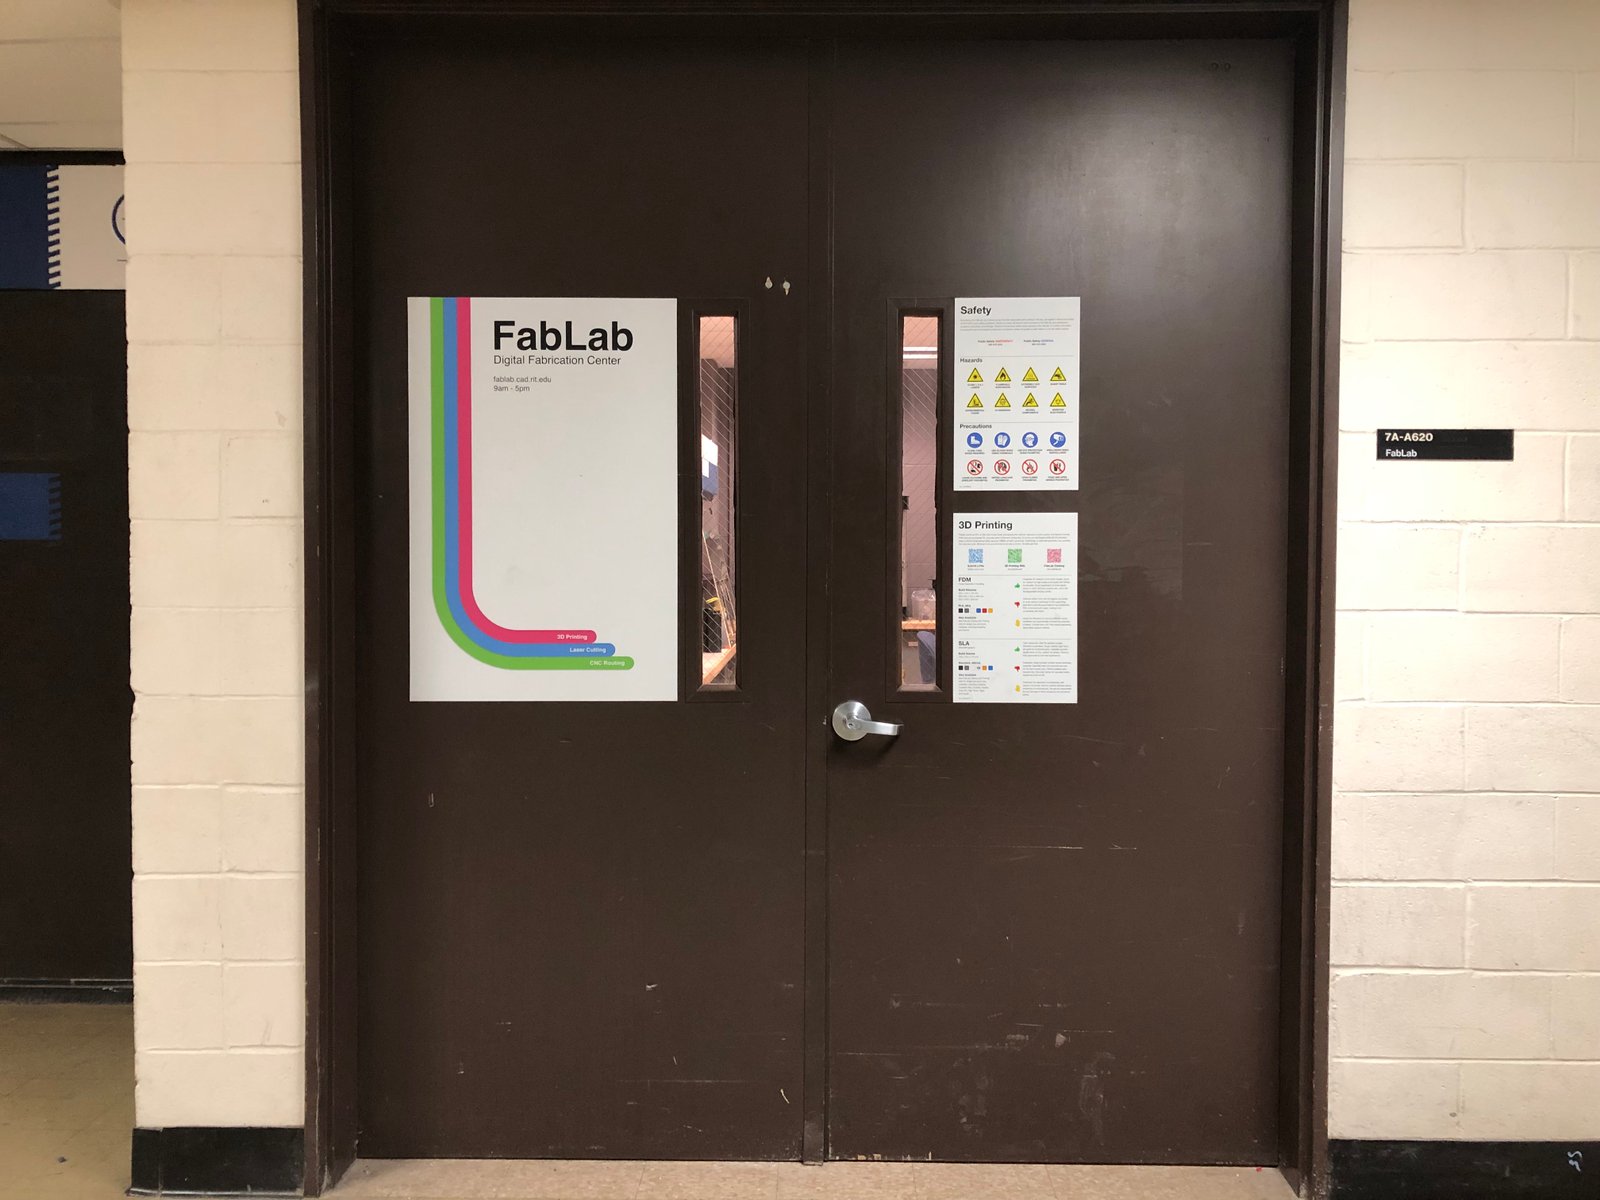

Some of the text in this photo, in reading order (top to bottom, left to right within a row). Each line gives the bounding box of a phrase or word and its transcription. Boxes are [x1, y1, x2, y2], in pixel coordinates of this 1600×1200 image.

[960, 305, 992, 316] Safety
[493, 320, 634, 352] FabLab
[493, 354, 621, 367] Digital Fabrication Center
[493, 375, 552, 383] fablab.cad.rit.edu
[514, 385, 531, 393] 5pm
[1384, 432, 1434, 442] 7A-A620
[1385, 448, 1418, 458] FabLab
[958, 520, 1013, 531] 3D Printing
